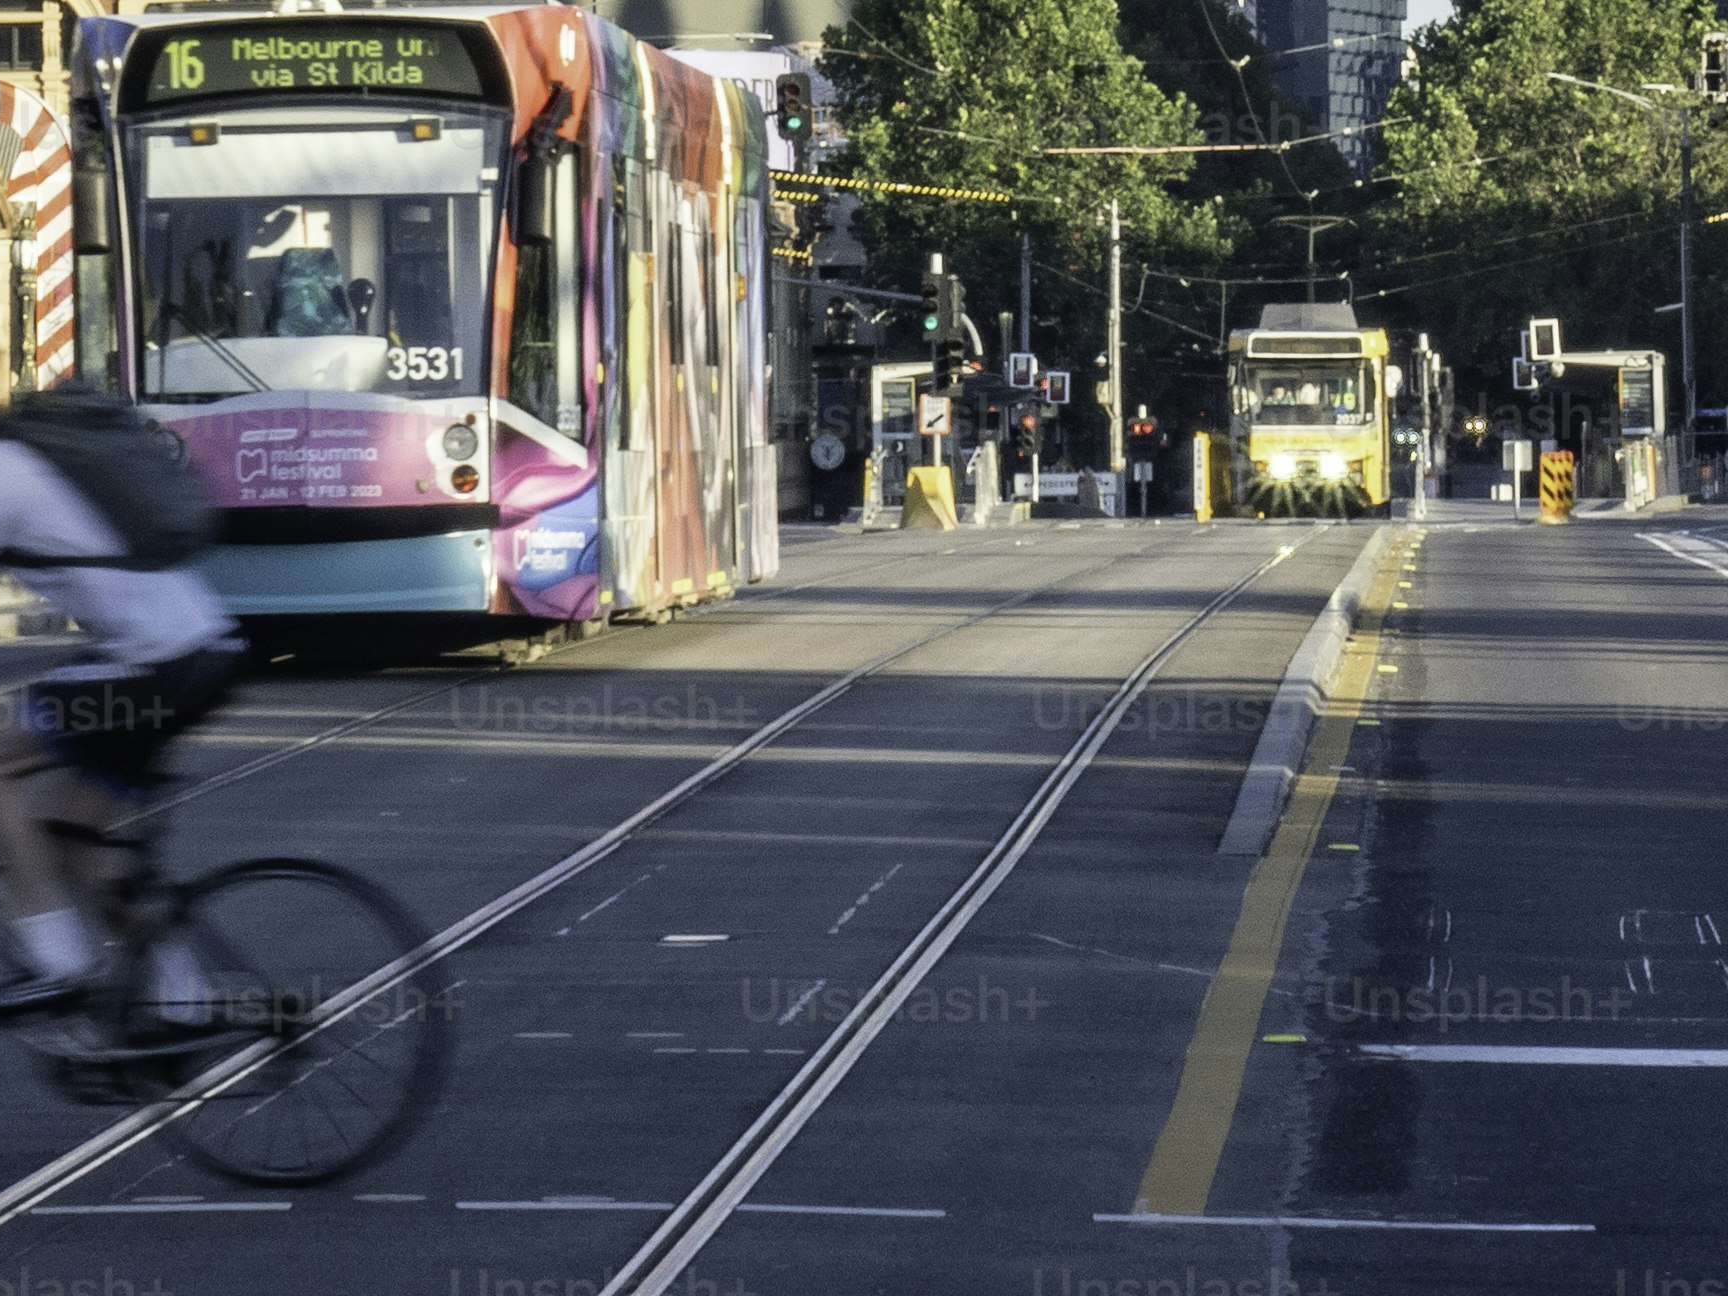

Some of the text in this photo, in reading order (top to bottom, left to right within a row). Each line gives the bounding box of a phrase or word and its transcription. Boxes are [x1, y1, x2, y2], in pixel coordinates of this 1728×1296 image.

[232, 37, 383, 61] Melbourne
[164, 40, 206, 89] 16
[251, 62, 422, 87] via St Kilda
[386, 347, 463, 381] 3531
[271, 446, 378, 462] midsumma
[271, 464, 342, 480] festival
